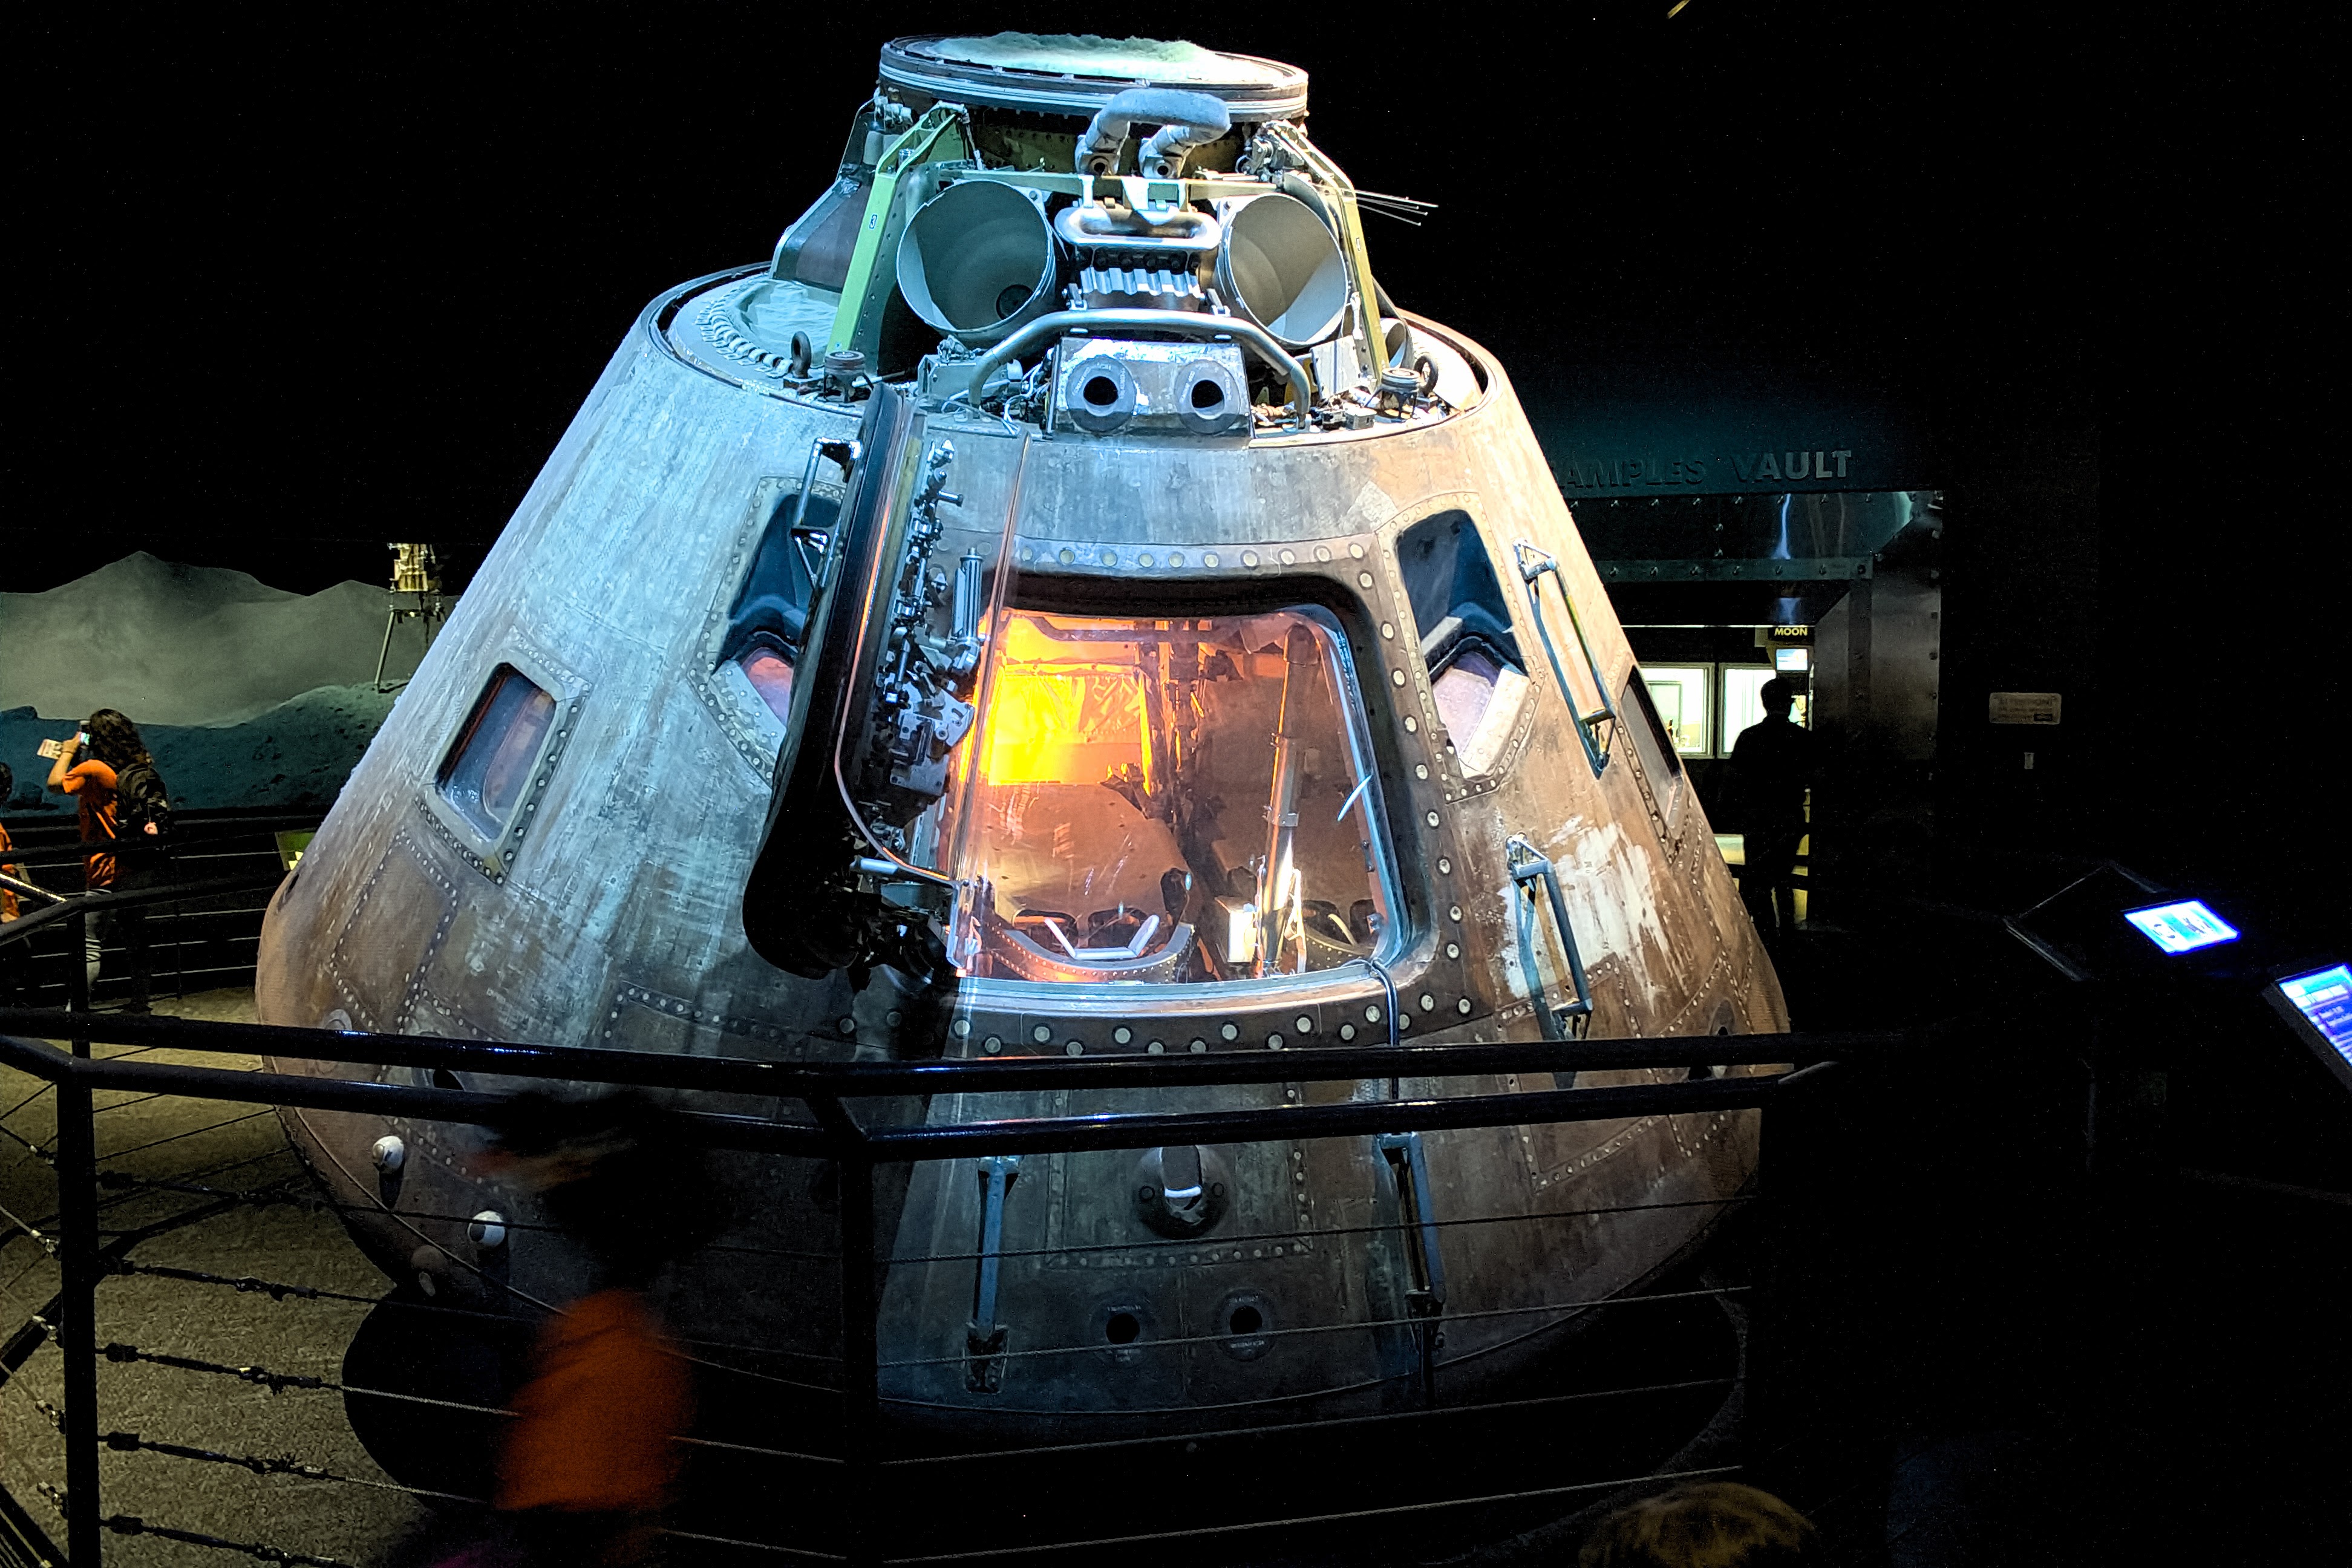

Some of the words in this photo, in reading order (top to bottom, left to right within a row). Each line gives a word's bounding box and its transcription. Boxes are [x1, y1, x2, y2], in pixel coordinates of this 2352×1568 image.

[869, 214, 877, 229] 3
[1551, 457, 1705, 488] AMPLES
[1729, 449, 1852, 483] VAULT
[1774, 627, 1808, 636] MOON
